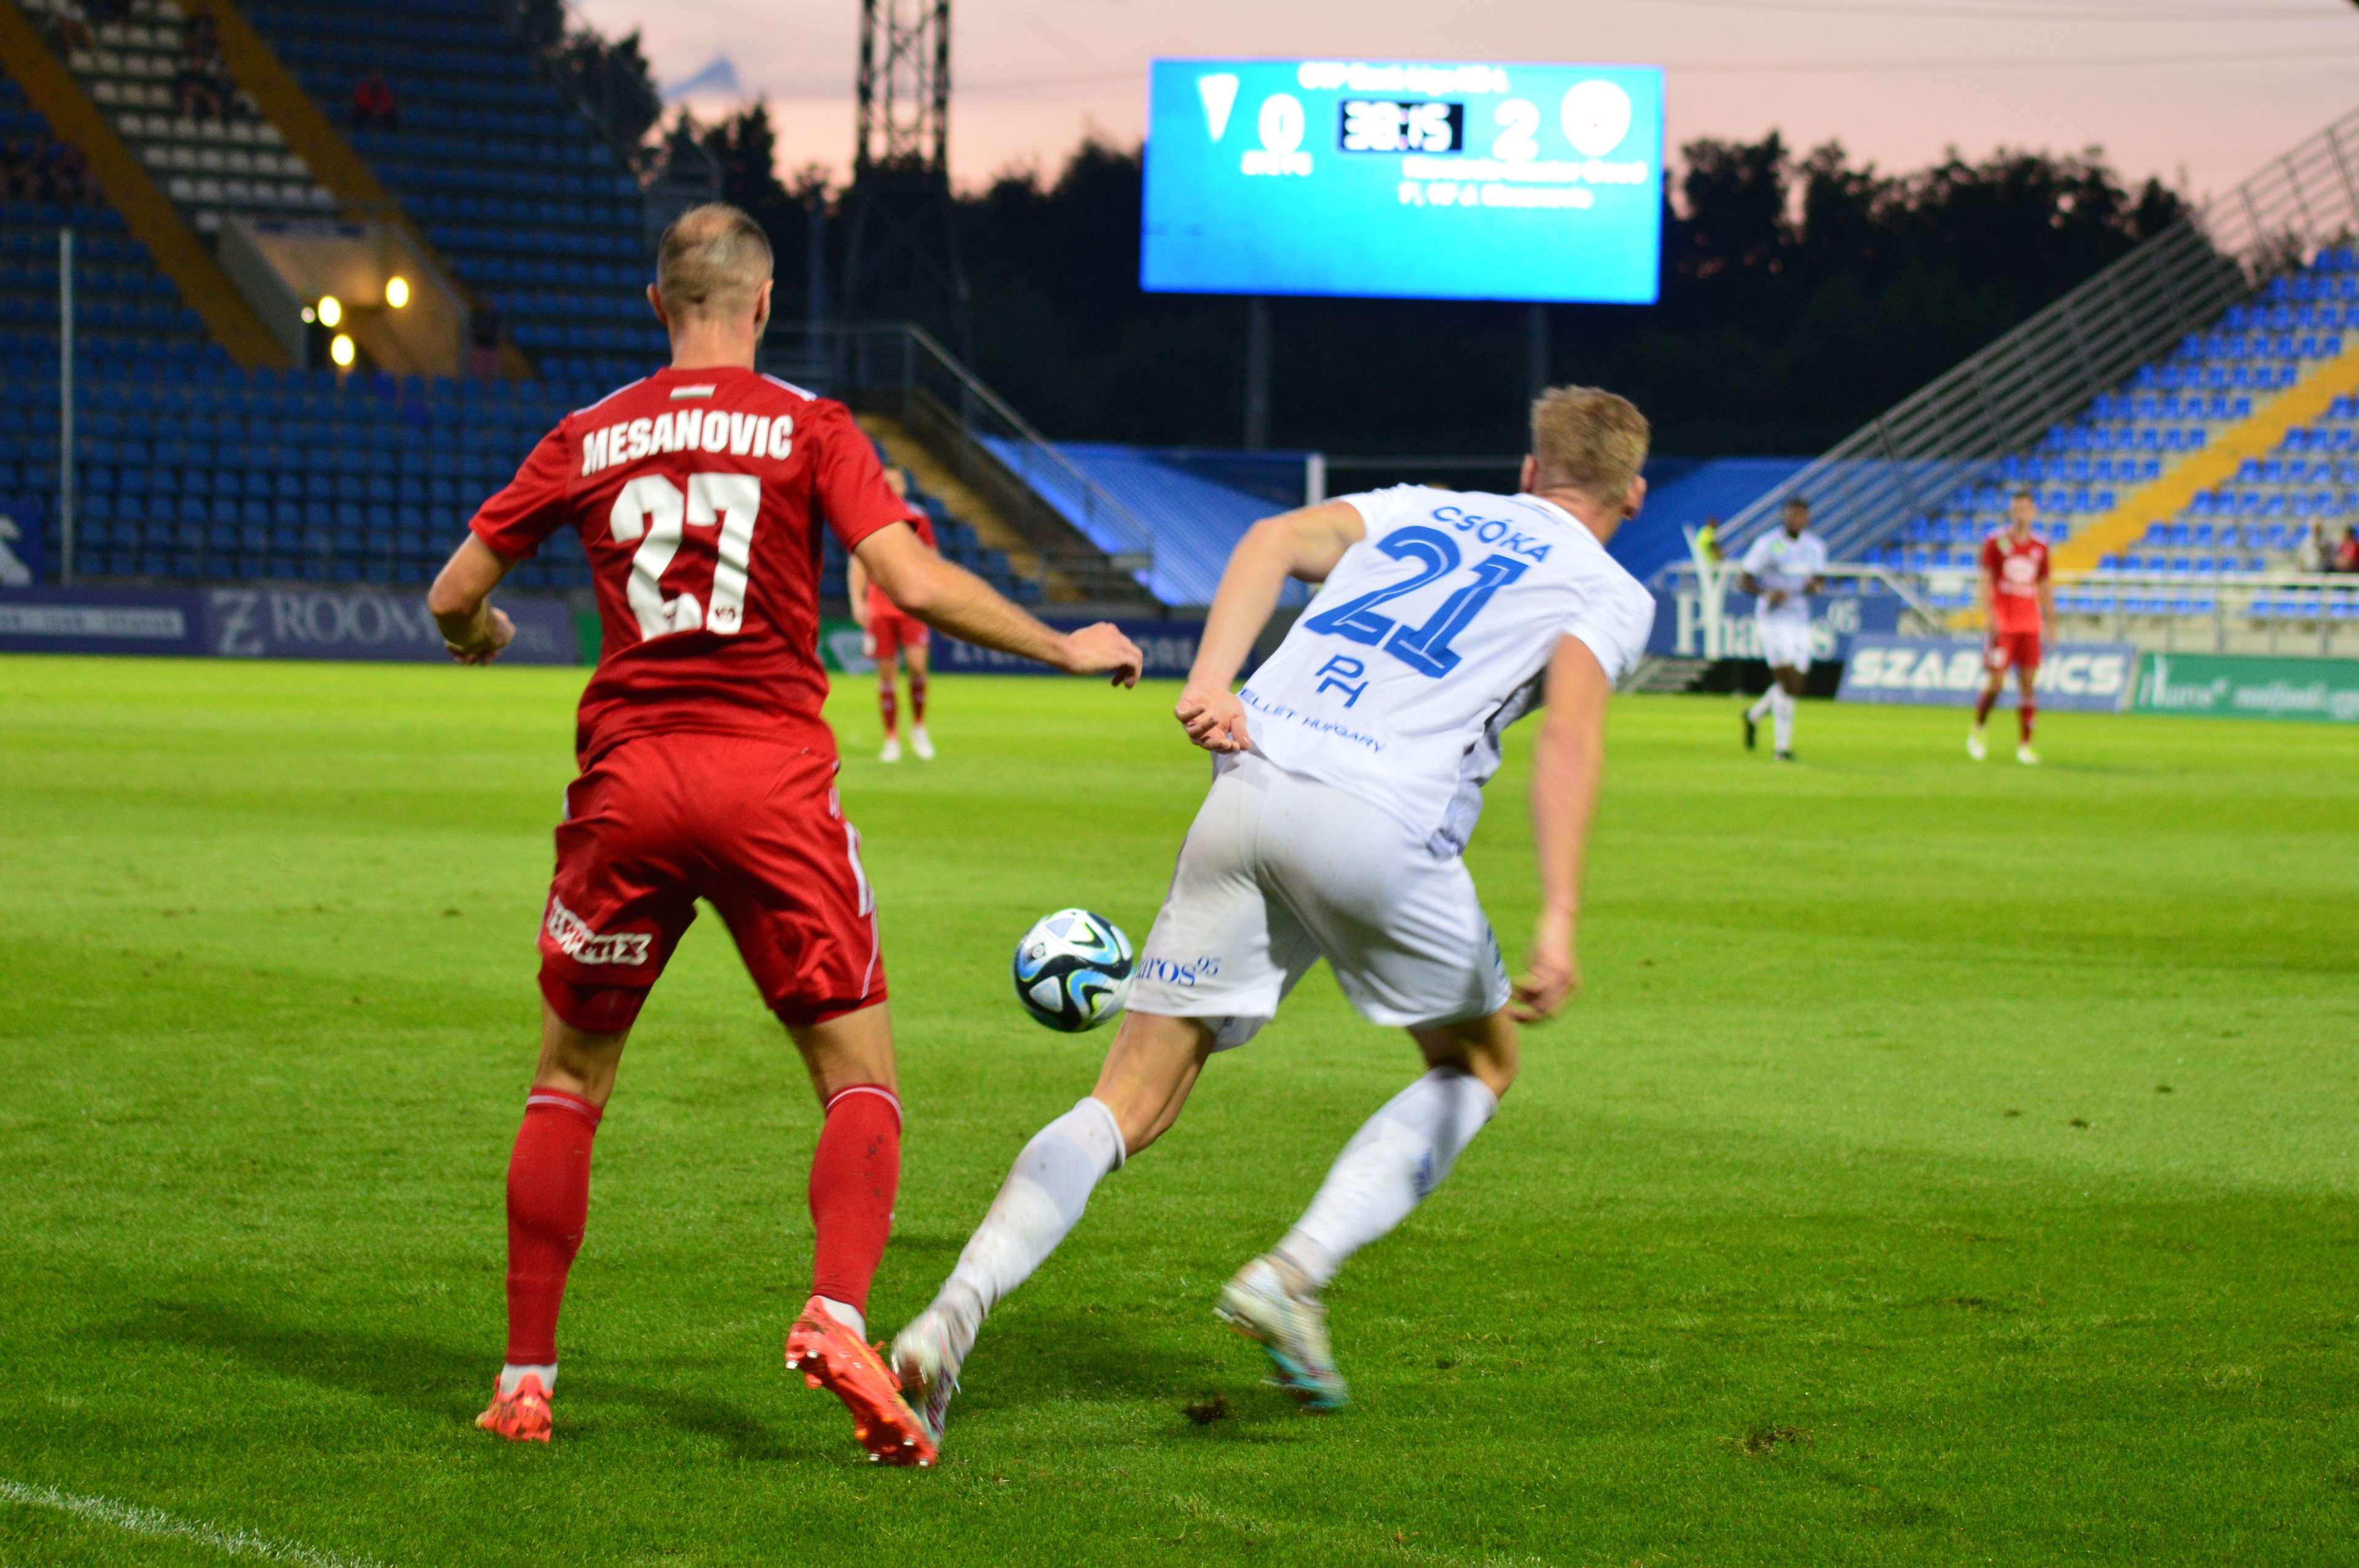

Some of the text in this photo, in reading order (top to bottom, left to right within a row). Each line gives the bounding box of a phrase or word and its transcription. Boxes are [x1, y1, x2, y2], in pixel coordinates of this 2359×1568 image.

[1258, 93, 1305, 155] 0
[1492, 98, 1539, 161] 2
[581, 408, 793, 477] MESANOVIC
[609, 472, 761, 643] 27
[1431, 505, 1554, 564] CSÓKA
[1304, 525, 1530, 679] 21
[1850, 646, 2124, 696] SZABICS
[1240, 687, 1299, 720] ELLET
